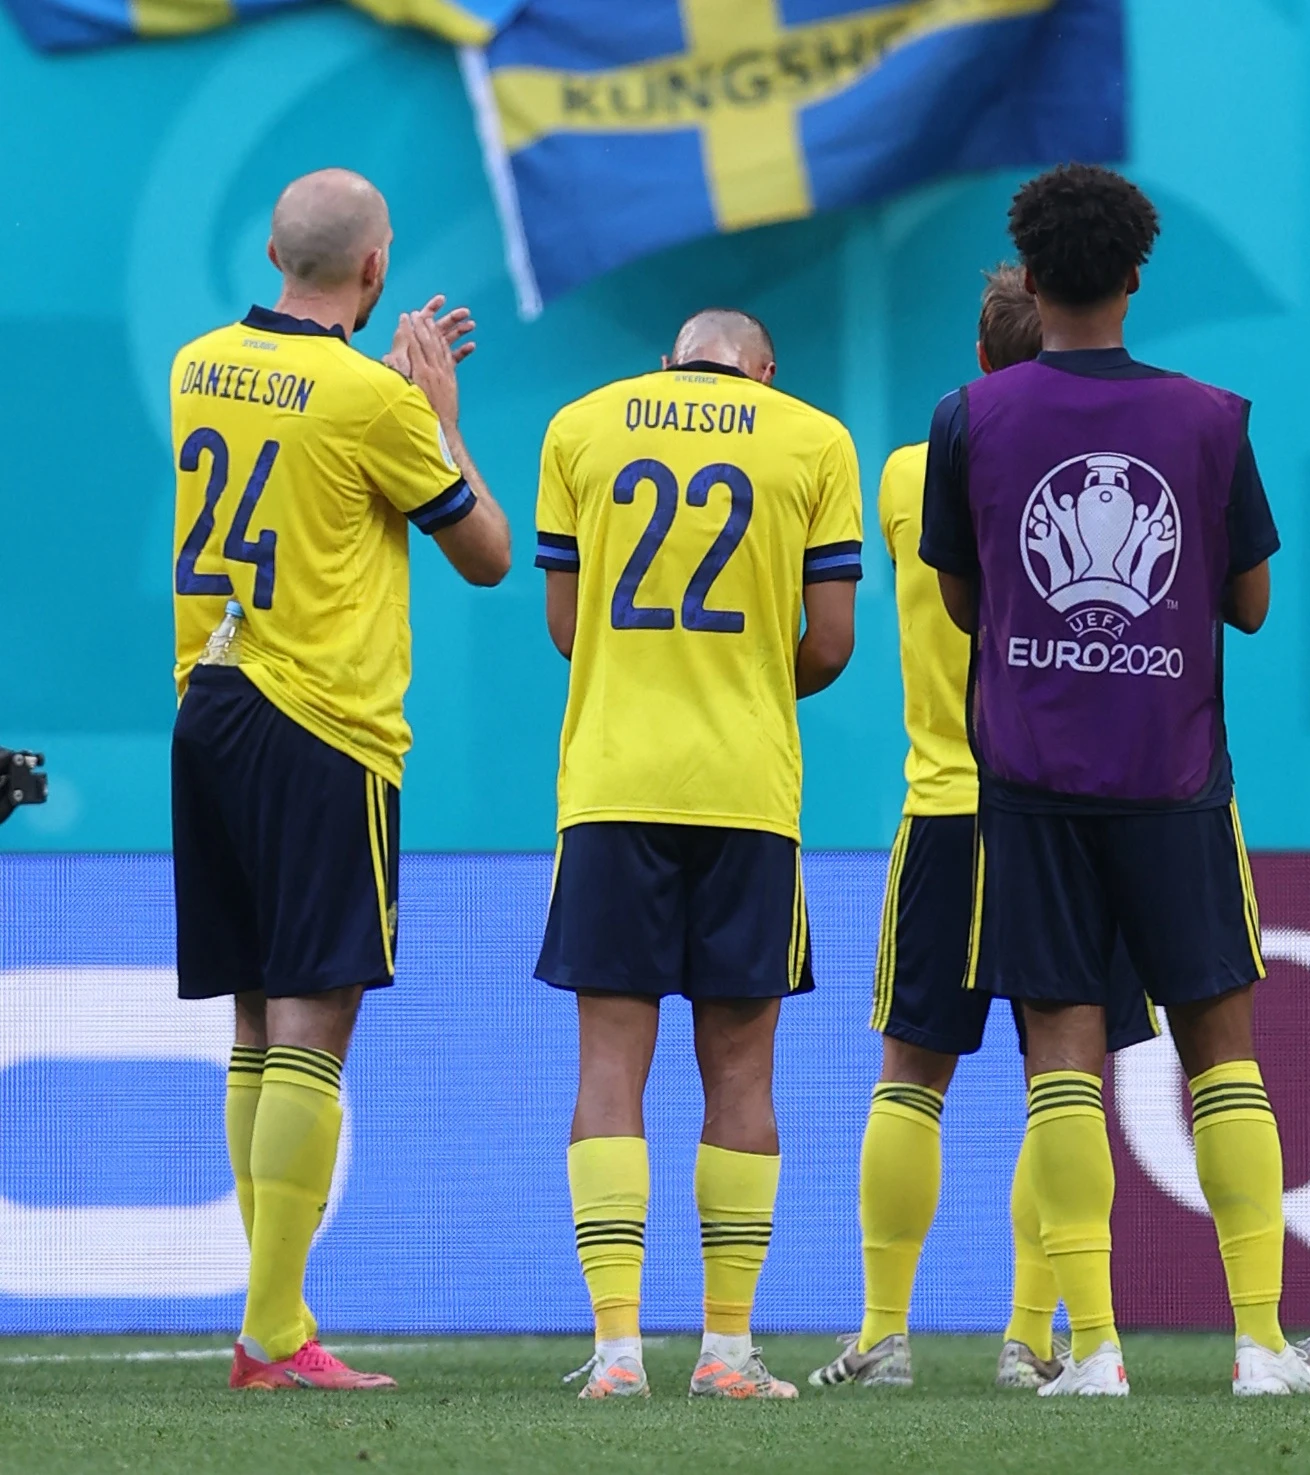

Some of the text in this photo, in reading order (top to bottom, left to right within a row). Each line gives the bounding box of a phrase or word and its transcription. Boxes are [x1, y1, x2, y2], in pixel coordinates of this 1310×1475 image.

[180, 360, 315, 413] DANIELSON
[626, 398, 756, 435] QUAISON
[176, 427, 280, 610] 24
[611, 458, 754, 634] 22
[1069, 612, 1125, 637] UEFA
